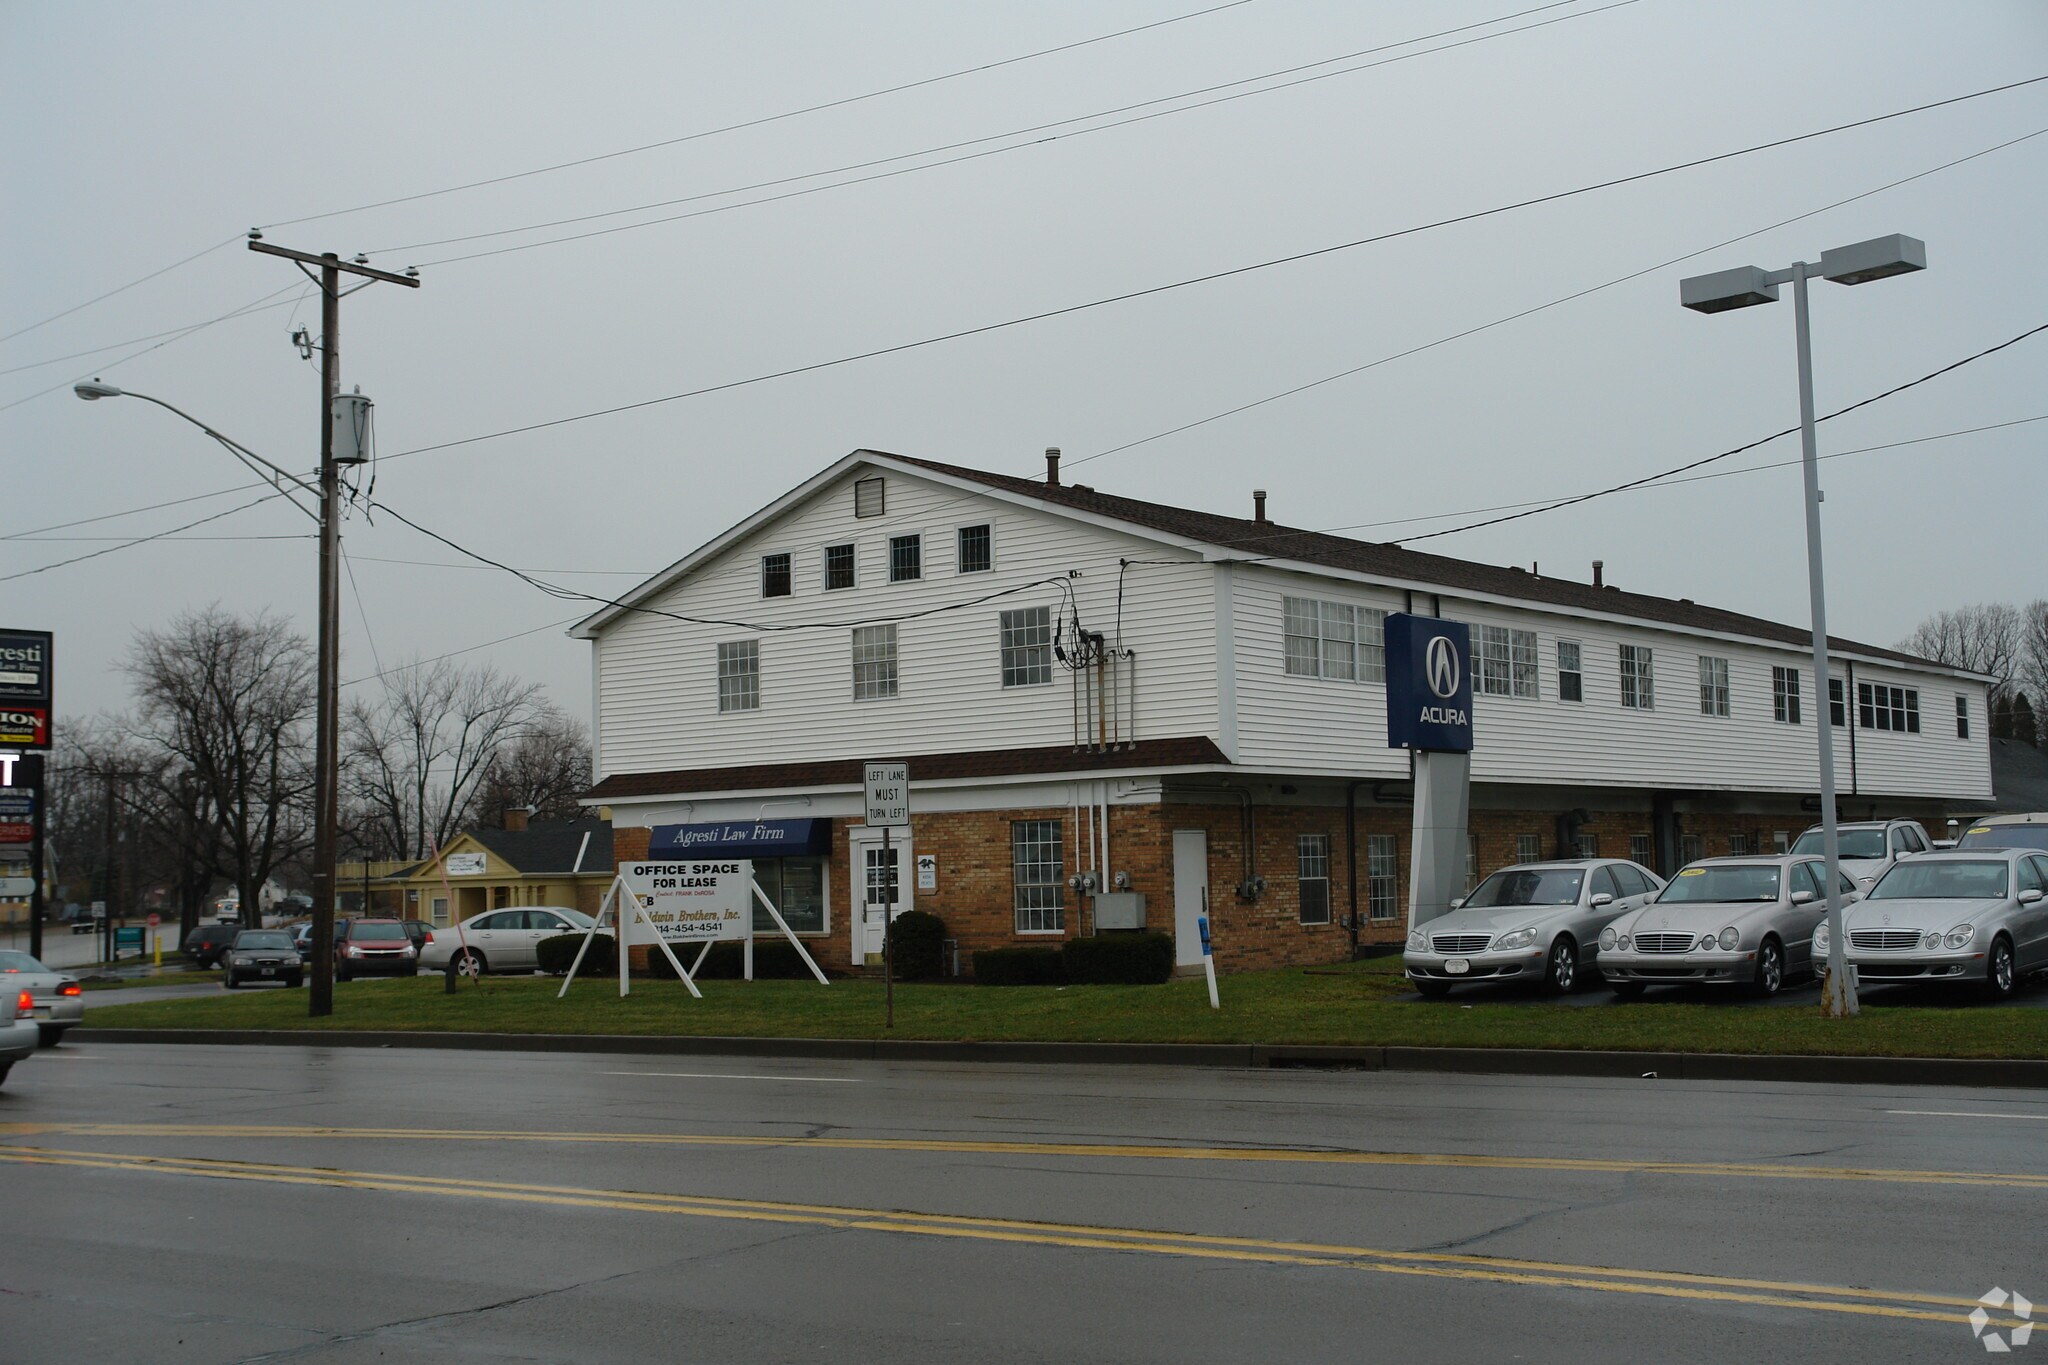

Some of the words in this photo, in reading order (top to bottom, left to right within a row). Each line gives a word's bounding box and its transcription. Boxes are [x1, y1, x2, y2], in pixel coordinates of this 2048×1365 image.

[1420, 706, 1468, 726] ACURA
[869, 771, 884, 781] LEFT
[889, 770, 905, 781] LANE
[875, 788, 898, 801] MUST
[870, 808, 886, 819] TURN
[890, 807, 906, 818] LEFT
[673, 828, 719, 847] Agresti
[721, 826, 749, 841] Law
[751, 825, 784, 840] Firm
[634, 865, 686, 876] OFFICE
[692, 864, 739, 875] SPACE
[653, 878, 676, 889] FOR
[681, 877, 717, 888] LEASE
[634, 911, 674, 924] Bldwin
[678, 909, 720, 922] Brothers,
[723, 908, 741, 920] Inc.
